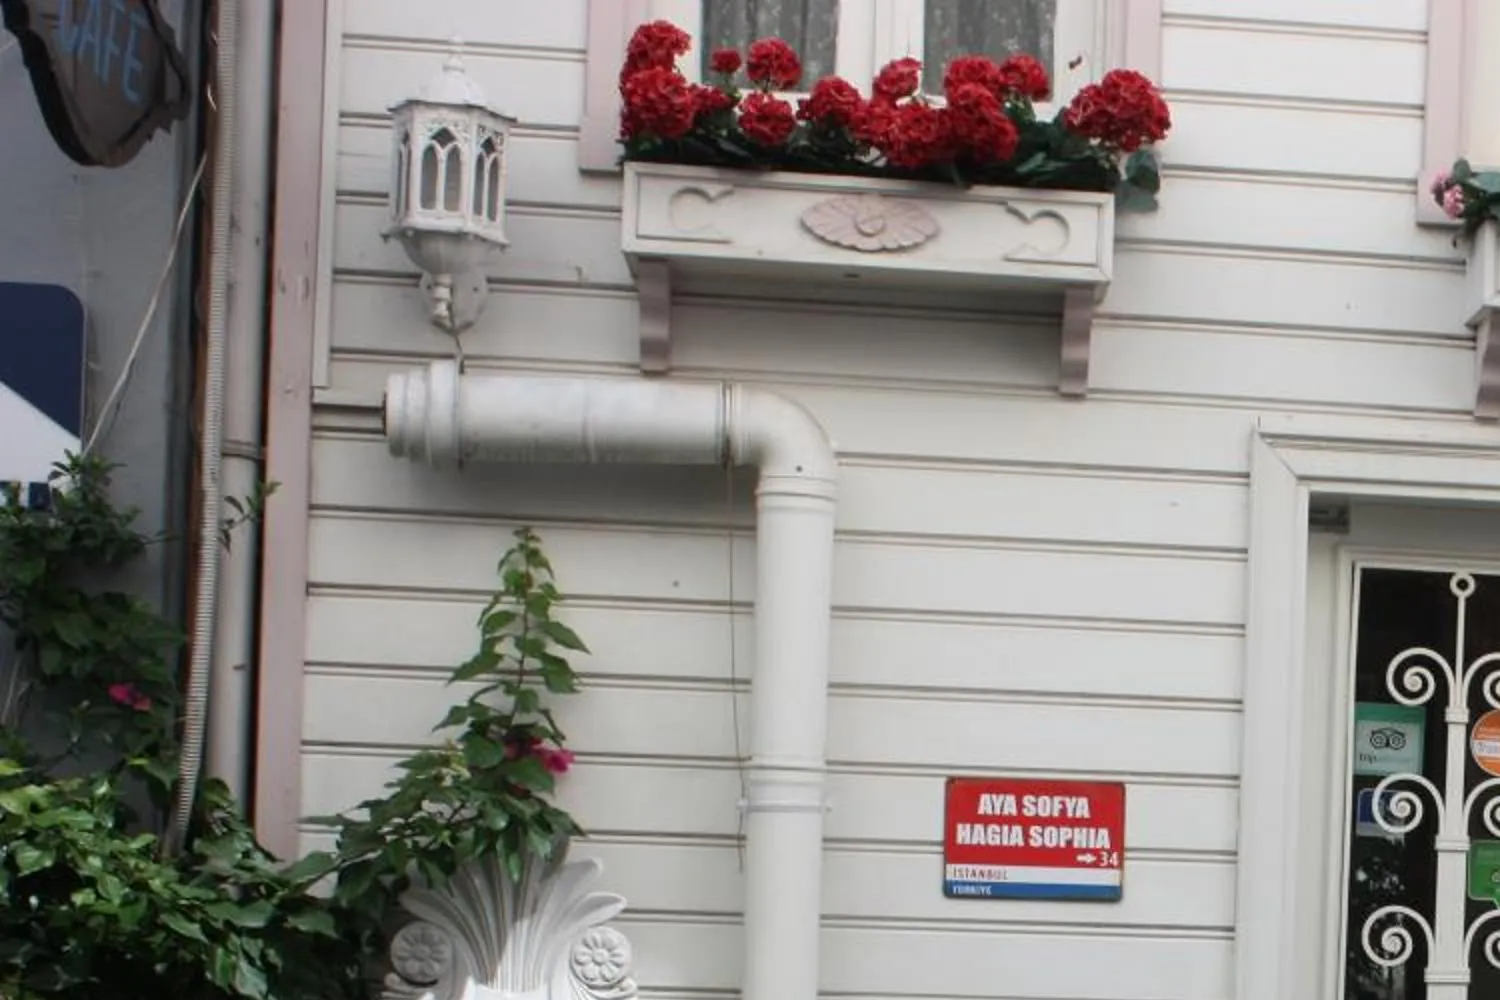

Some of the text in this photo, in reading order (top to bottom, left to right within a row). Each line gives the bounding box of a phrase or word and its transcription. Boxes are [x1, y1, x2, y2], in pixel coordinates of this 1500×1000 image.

[977, 793, 1091, 819] AYA SOFYA
[956, 823, 1111, 849] HAGIA SOPHIA
[1100, 852, 1119, 867] 34
